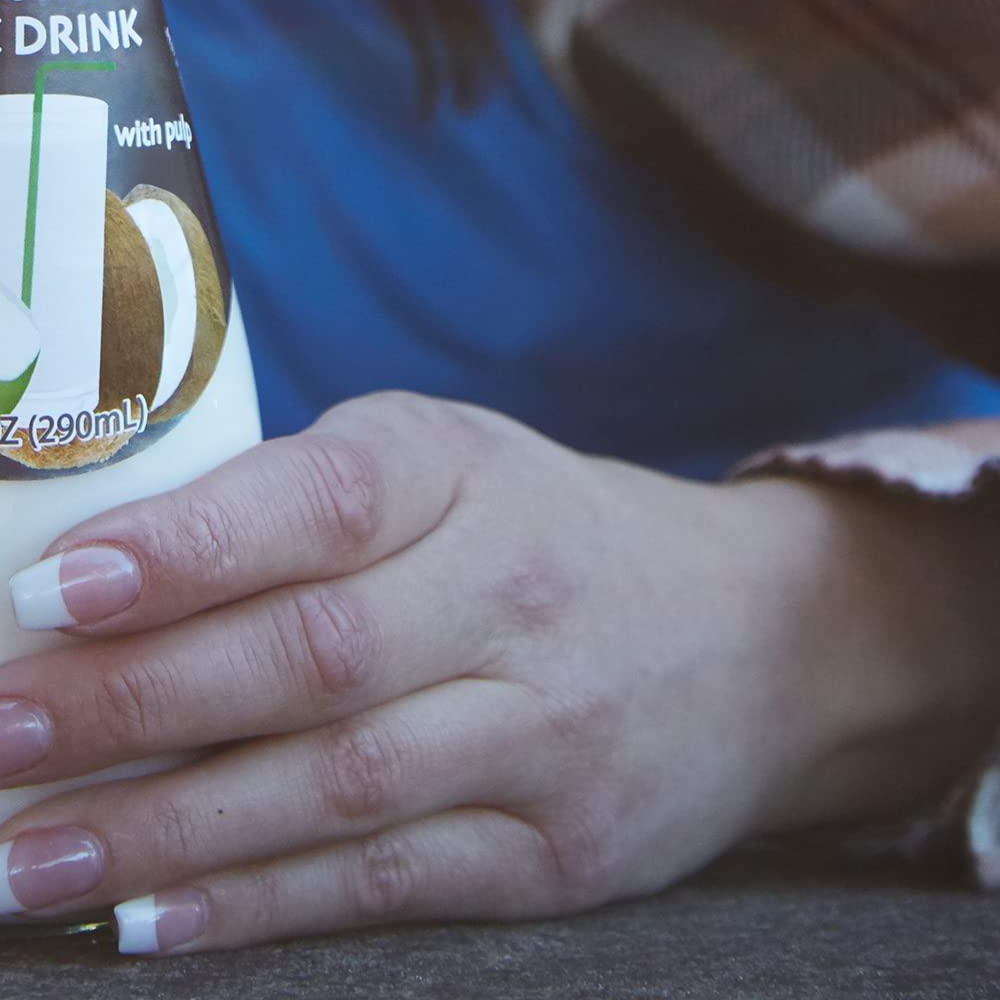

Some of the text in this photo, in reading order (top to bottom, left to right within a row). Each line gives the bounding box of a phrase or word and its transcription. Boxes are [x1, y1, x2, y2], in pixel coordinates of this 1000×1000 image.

[15, 7, 143, 55] DRINK
[113, 113, 192, 151] with pulp
[27, 393, 150, 452] (290mL)
